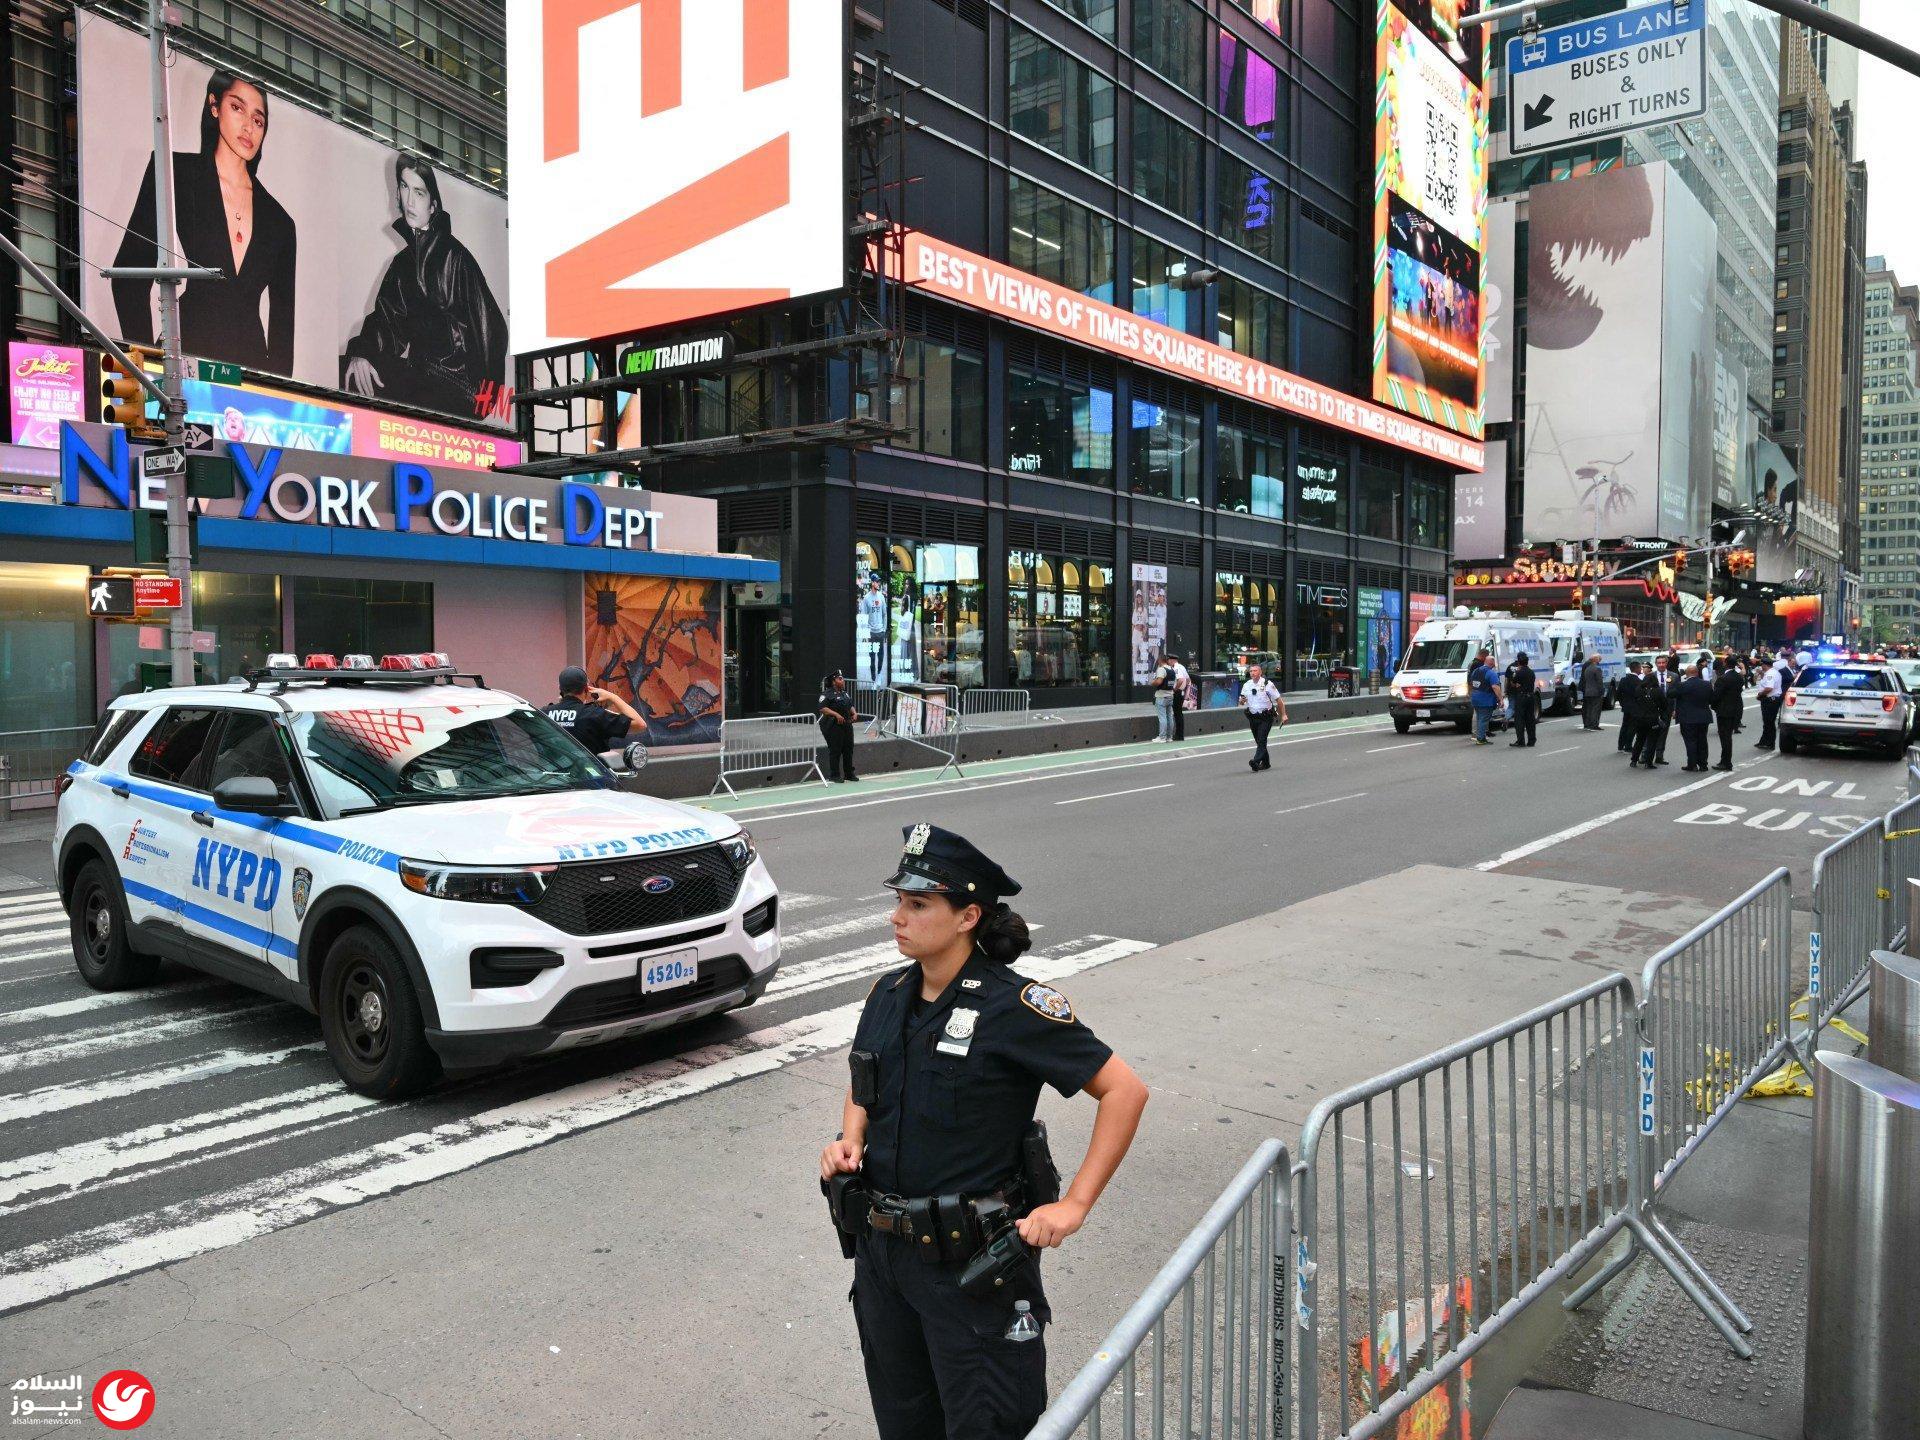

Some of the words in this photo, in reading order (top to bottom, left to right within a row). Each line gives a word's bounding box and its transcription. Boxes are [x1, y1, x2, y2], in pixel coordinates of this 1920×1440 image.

[1559, 27, 1607, 53] BUS
[1618, 6, 1690, 39] LANE
[1571, 52, 1629, 80] BUSES
[1638, 37, 1687, 64] ONLY
[1621, 75, 1636, 93] &
[1569, 103, 1622, 129] RIGHT
[1629, 87, 1690, 113] TURNS
[918, 244, 978, 295] BEST
[982, 268, 1052, 321] VIEWS
[1056, 296, 1082, 330] OF
[1086, 306, 1140, 351] TIMES
[1142, 328, 1205, 374] SQUARE
[1207, 351, 1243, 386] HERE
[1269, 374, 1318, 411] TICKETS
[1319, 391, 1335, 417] TO
[1335, 399, 1356, 425] THE
[1356, 406, 1386, 434] TIMES
[1386, 416, 1422, 446] SQUARE
[208, 364, 216, 380] 7
[474, 377, 514, 424] H&M
[379, 420, 496, 453] BROADWAY'S
[379, 434, 441, 459] BIGGEST
[445, 446, 472, 464] POP
[475, 453, 497, 468] HIT
[147, 455, 160, 468] ONE
[166, 451, 180, 465] WAY
[59, 420, 210, 514] NE
[226, 442, 380, 528] YORK
[392, 462, 549, 542] POLICE
[562, 482, 664, 550] DEPT
[1455, 515, 1475, 525] AX
[1513, 557, 1620, 581] Subway
[135, 587, 160, 595] Anytime
[1296, 584, 1348, 608] TIMES
[548, 709, 576, 721] NYPD
[1673, 803, 1873, 838] BUS
[337, 839, 383, 865] POLICE
[556, 839, 629, 861] NYPD
[632, 827, 714, 852] POLICE
[192, 836, 282, 912] NYPD
[650, 879, 669, 892] Ford
[1810, 934, 1820, 994] NYPD
[1641, 1051, 1653, 1132] NYPD
